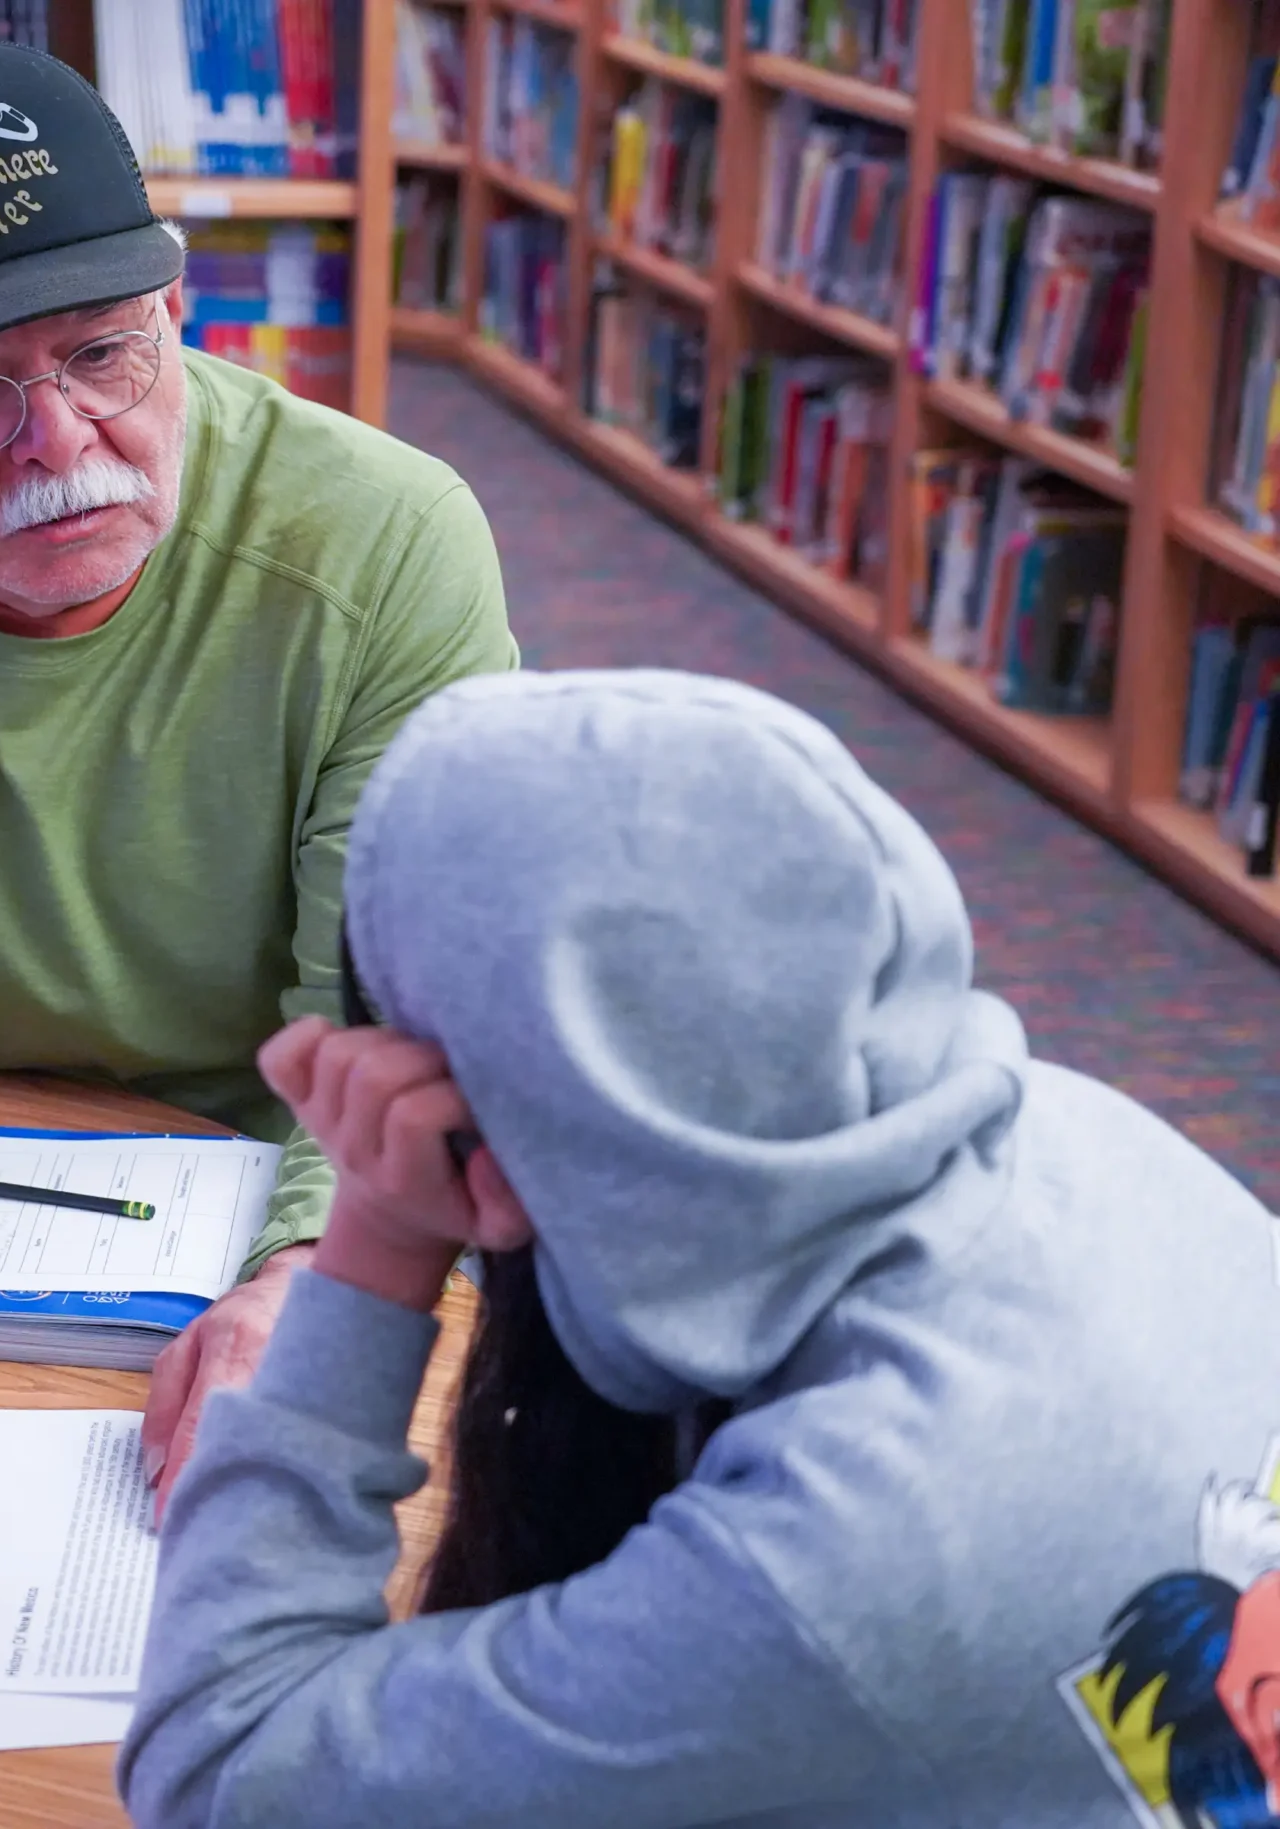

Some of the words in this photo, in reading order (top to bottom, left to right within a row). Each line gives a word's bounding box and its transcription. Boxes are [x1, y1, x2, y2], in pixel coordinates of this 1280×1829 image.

[20, 1586, 39, 1613] Mexico
[16, 1616, 31, 1633] New
[5, 1647, 28, 1678] History
